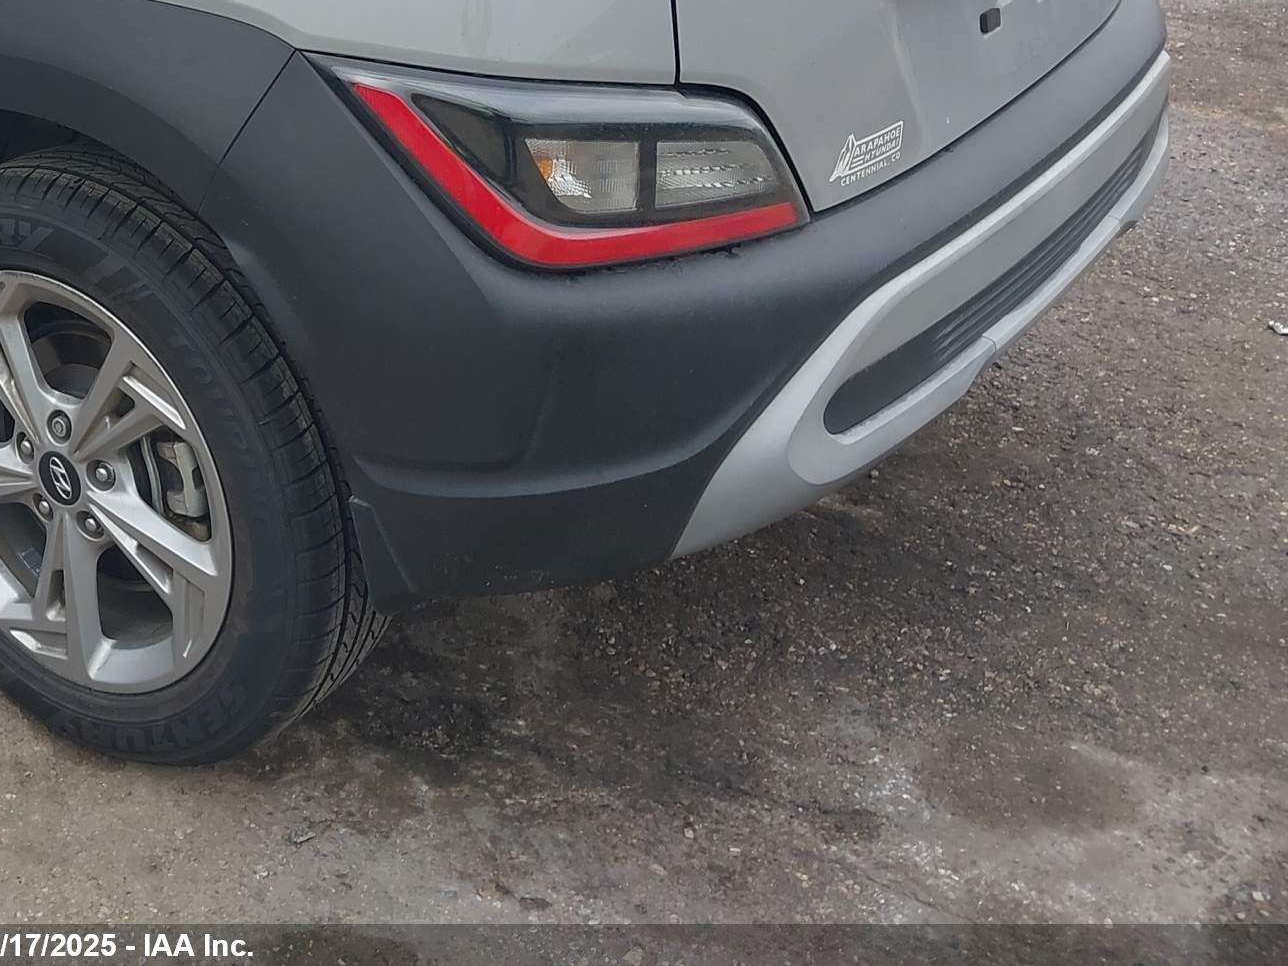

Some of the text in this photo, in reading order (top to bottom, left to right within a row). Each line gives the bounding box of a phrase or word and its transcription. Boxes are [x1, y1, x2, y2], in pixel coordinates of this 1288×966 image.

[854, 127, 901, 156] ARAPAHOE
[864, 138, 899, 162] HYUNDAI
[891, 151, 901, 162] CO
